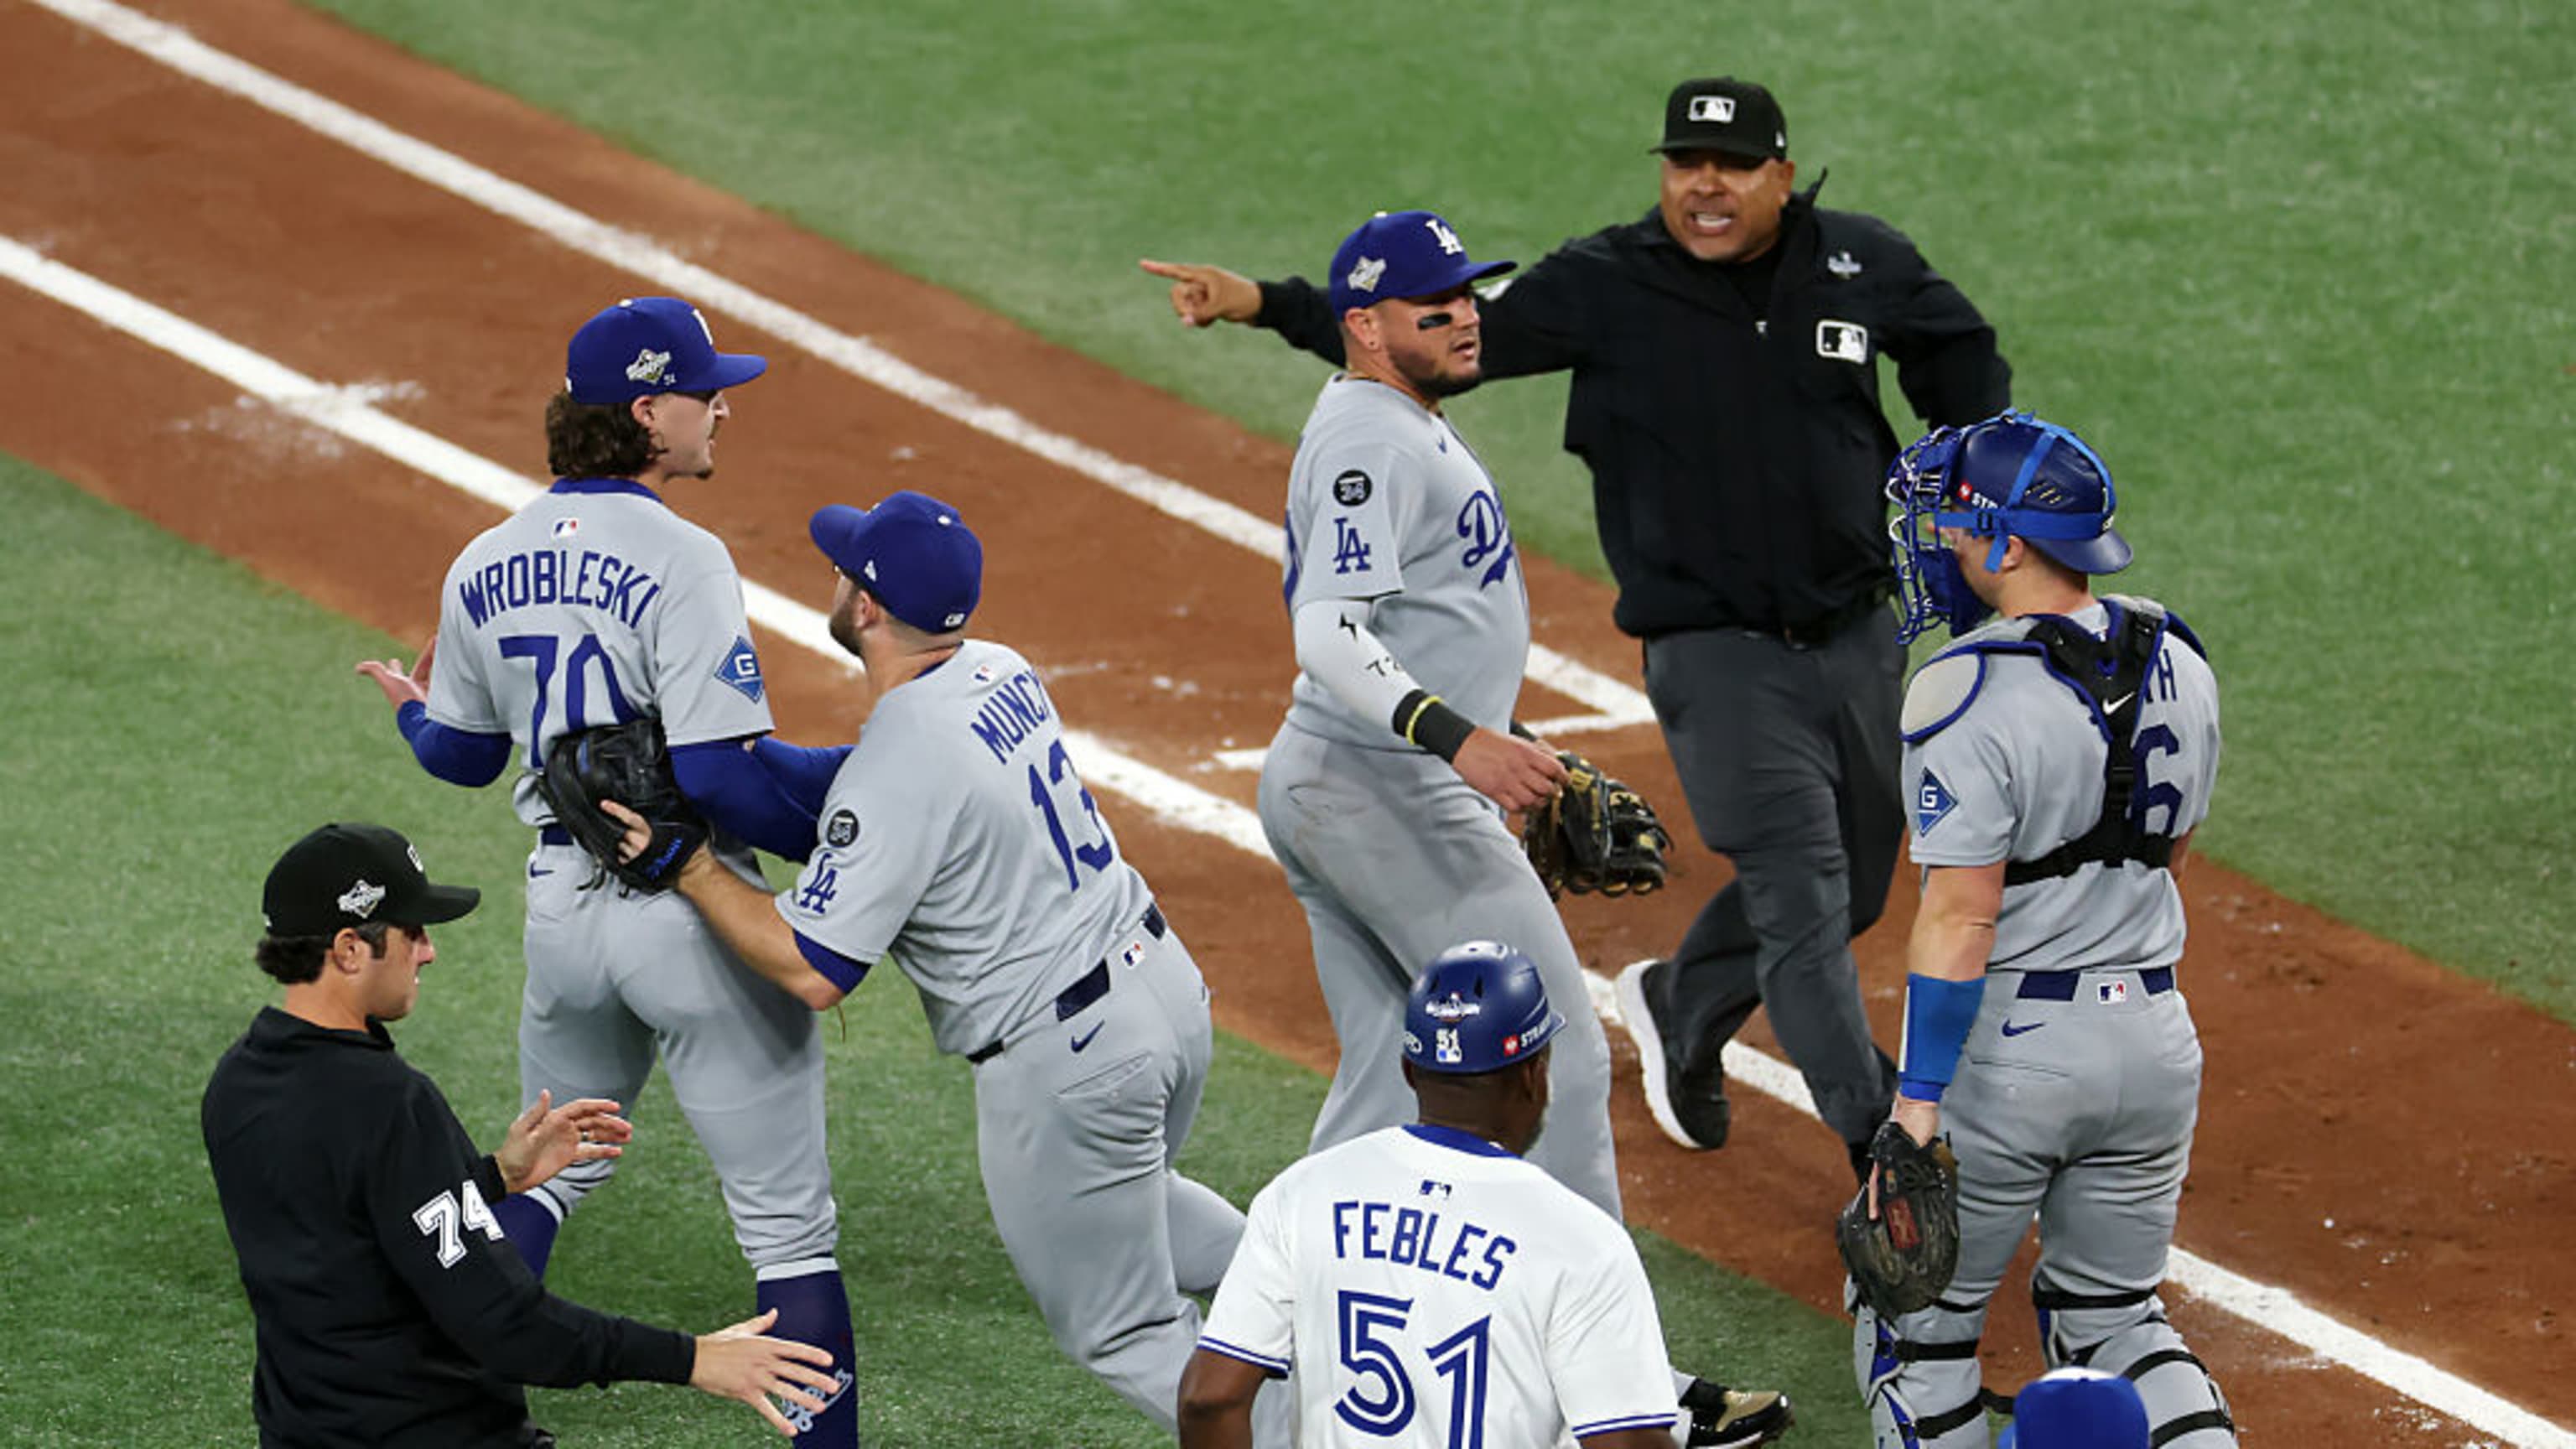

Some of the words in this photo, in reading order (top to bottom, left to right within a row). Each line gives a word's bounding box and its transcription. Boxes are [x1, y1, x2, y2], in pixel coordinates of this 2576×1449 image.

[1332, 517, 1372, 574] LA
[460, 549, 660, 629] WROBLESKI
[497, 632, 641, 768] 70
[1029, 739, 1114, 894] 13
[1921, 785, 1938, 808] G
[799, 852, 839, 914] LA
[1436, 1027, 1459, 1048] 51
[411, 1179, 506, 1270] 74
[1332, 1200, 1517, 1291] FEBLES
[1332, 1289, 1493, 1449] 51
